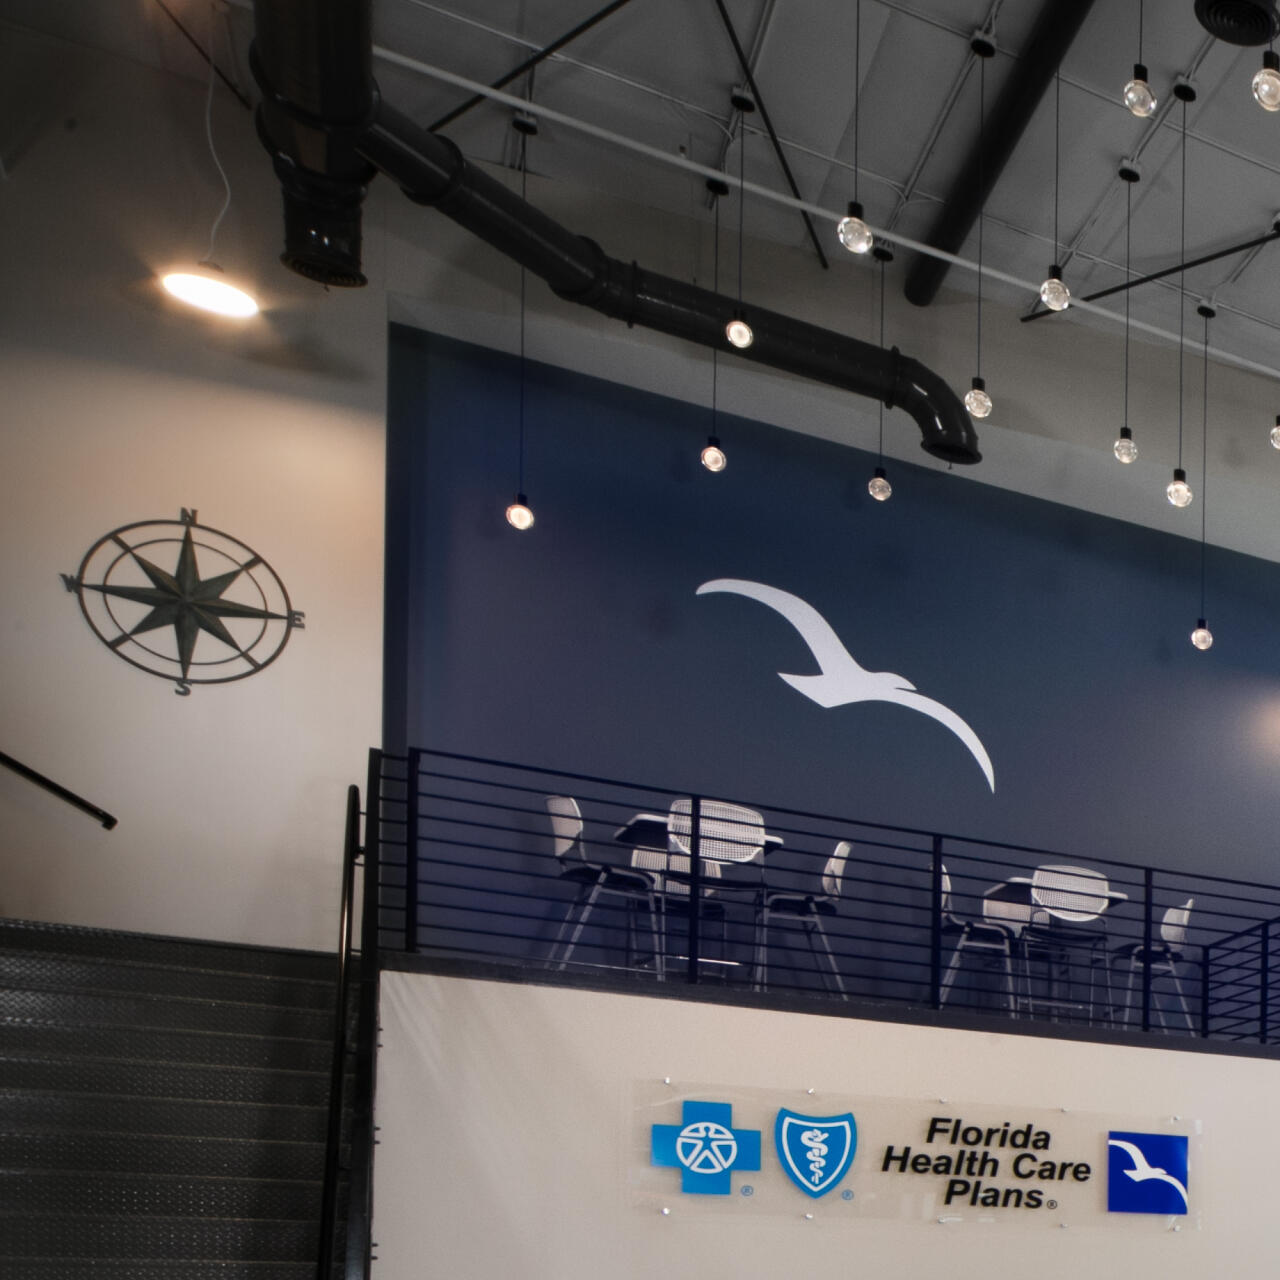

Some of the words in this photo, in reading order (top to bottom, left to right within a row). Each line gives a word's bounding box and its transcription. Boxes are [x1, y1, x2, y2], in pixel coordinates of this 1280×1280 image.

[181, 507, 198, 525] N
[926, 1116, 1051, 1150] Florida
[882, 1146, 999, 1177] Health
[1013, 1153, 1091, 1182] Care
